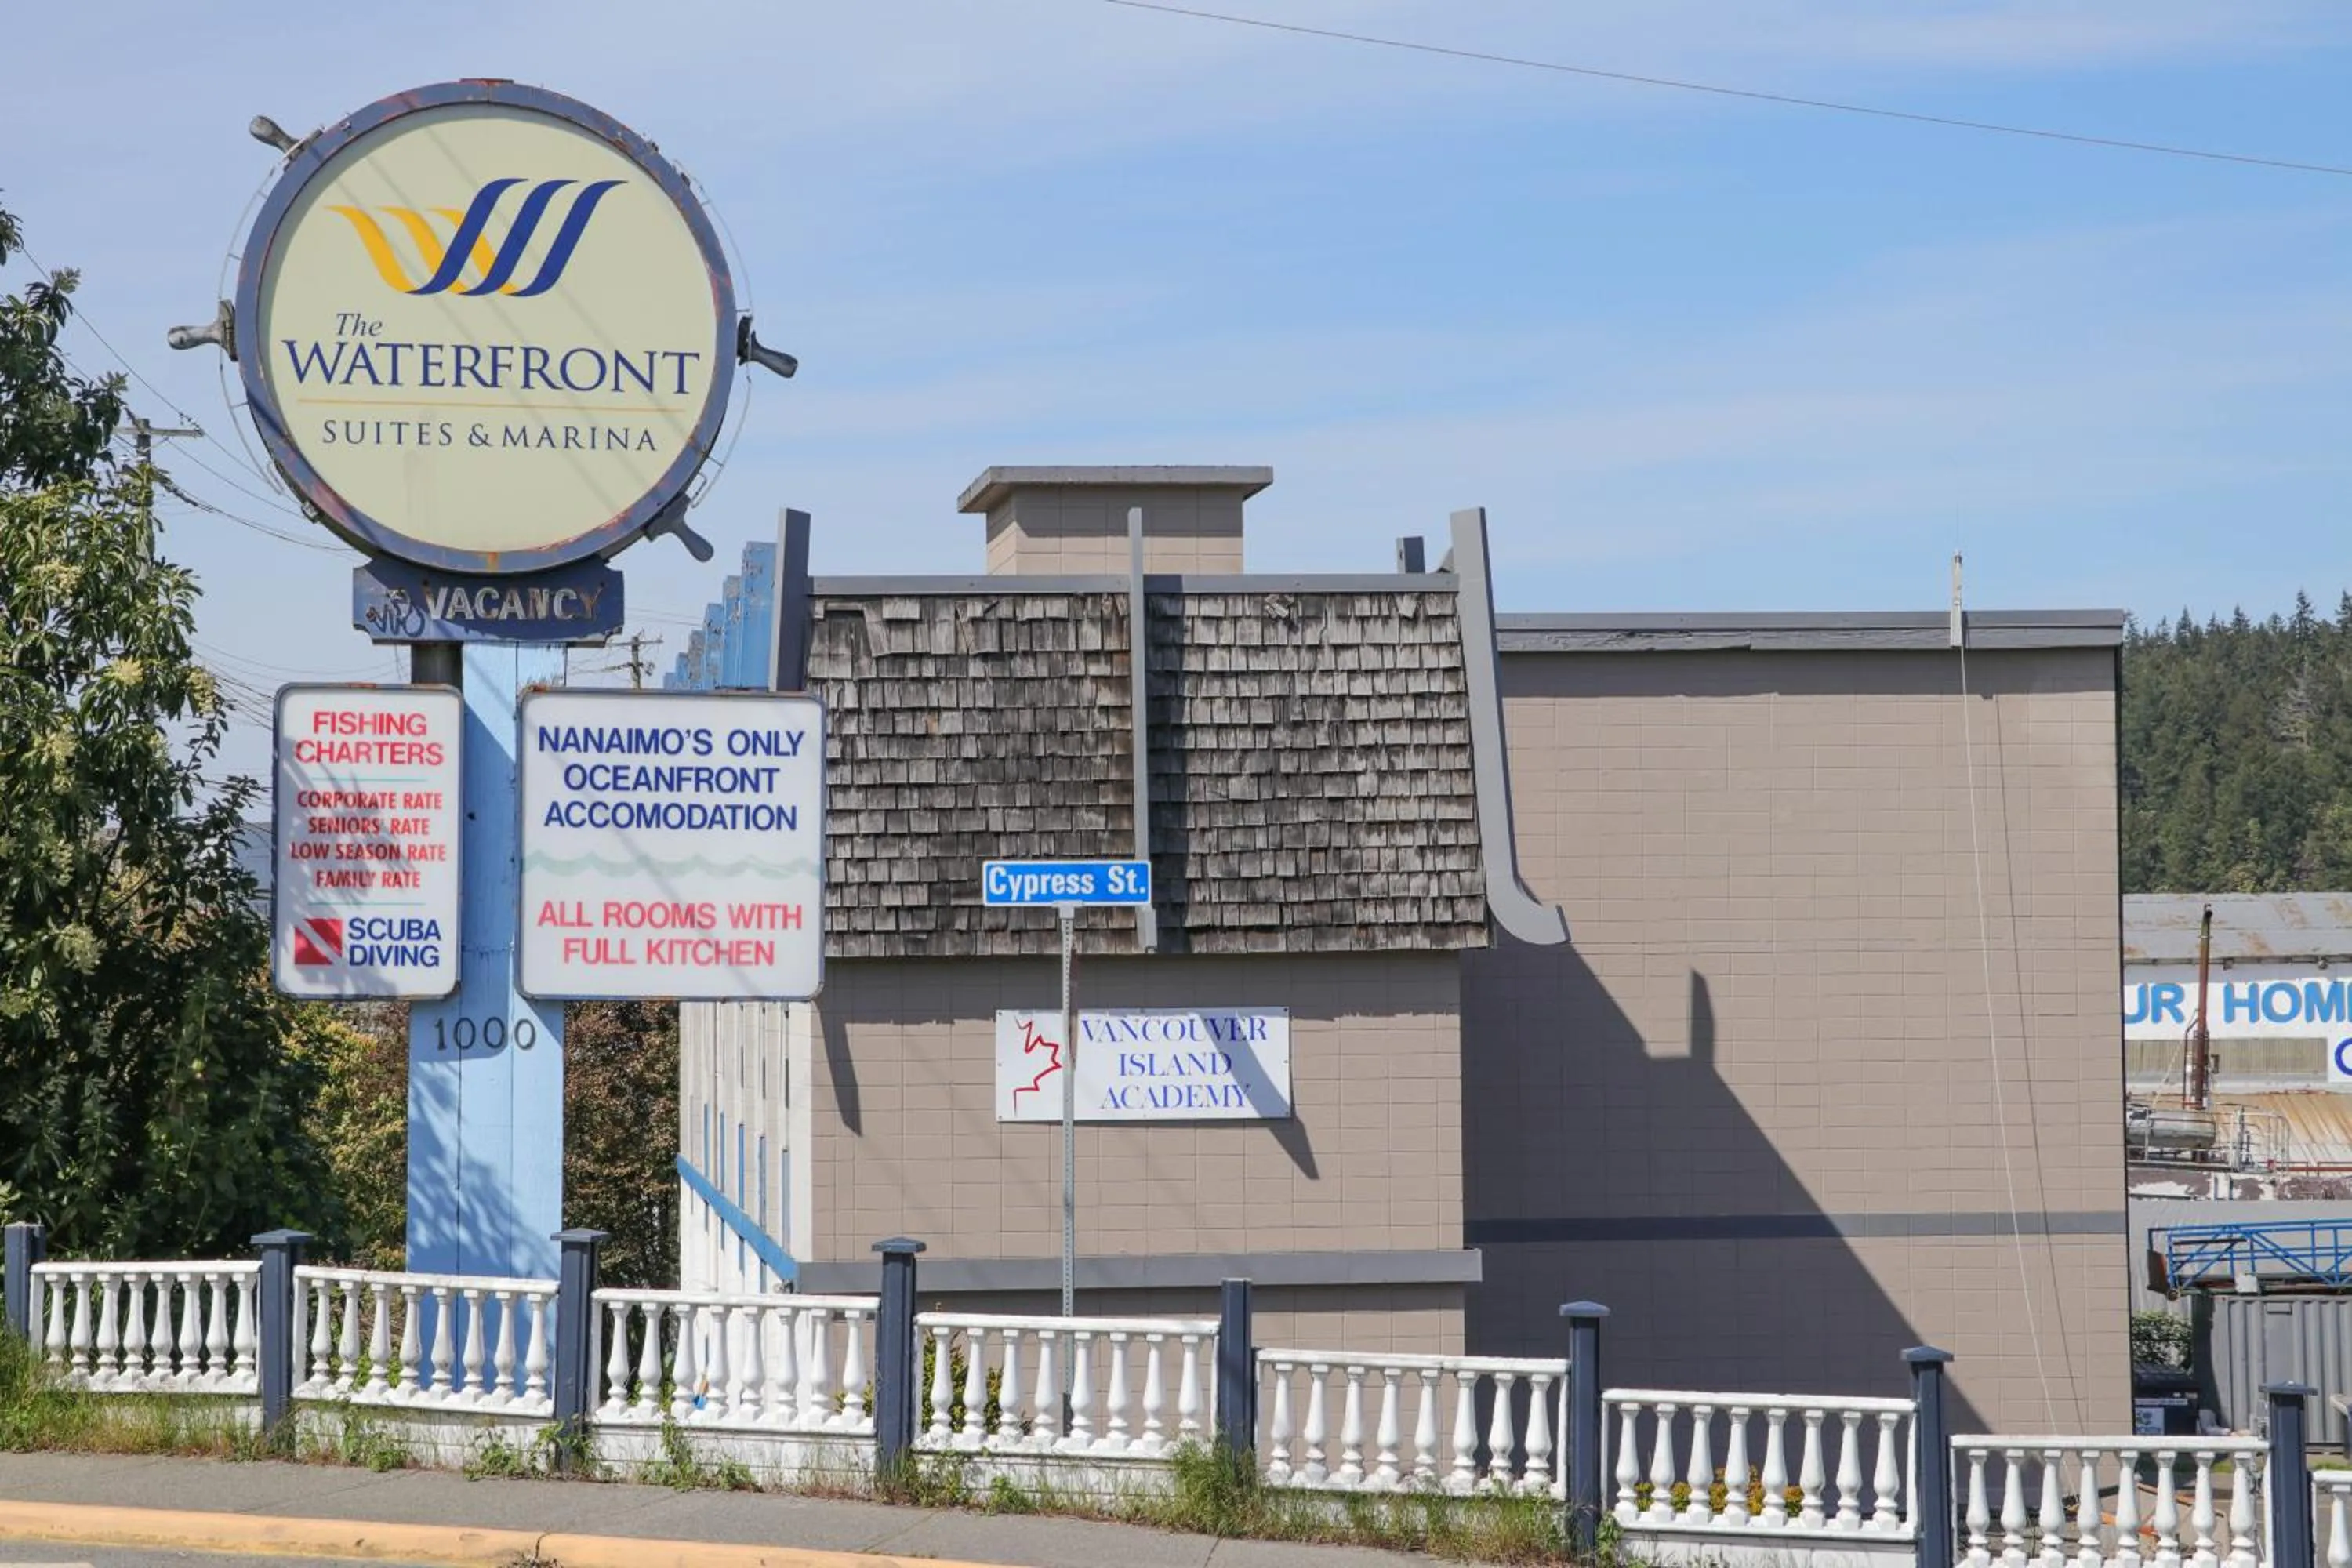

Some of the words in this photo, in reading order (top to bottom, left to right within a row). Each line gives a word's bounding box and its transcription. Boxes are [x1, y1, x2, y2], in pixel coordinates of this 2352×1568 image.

[336, 314, 383, 337] The
[282, 339, 700, 395] WATERFRONT
[322, 419, 452, 447] SUITES
[468, 423, 491, 447] &
[503, 425, 656, 452] MARINA
[424, 587, 602, 620] VACANCY
[314, 712, 426, 735] FISHING
[296, 740, 444, 766] CHARTERS
[539, 726, 713, 756] NANAIMO'S
[728, 730, 805, 757] ONLY
[564, 764, 780, 793] OCEANFRONT
[298, 791, 397, 810] CORPORATE
[404, 792, 442, 810] RATE
[390, 818, 430, 837] RATE
[544, 801, 797, 831] ACCOMODATION
[291, 842, 331, 859] LOW
[335, 844, 401, 861] SEASON
[407, 844, 446, 862] RATE
[316, 869, 377, 888] FAMILY
[381, 871, 421, 889] RATE
[989, 866, 1094, 900] Cypress
[1108, 866, 1145, 894] St.
[537, 901, 593, 928] ALL
[604, 901, 716, 930] ROOMS
[728, 904, 801, 930] WITH
[349, 917, 441, 941] SCUBA
[349, 945, 440, 967] DIVING
[564, 938, 636, 964] FULL
[648, 940, 774, 967] KITCHEN
[2223, 981, 2352, 1023] HOM
[436, 1018, 536, 1051] 1000
[1082, 1017, 1267, 1042] VANCOUVER
[1119, 1053, 1231, 1076] ISLAND
[1100, 1083, 1251, 1109] ACADEMY
